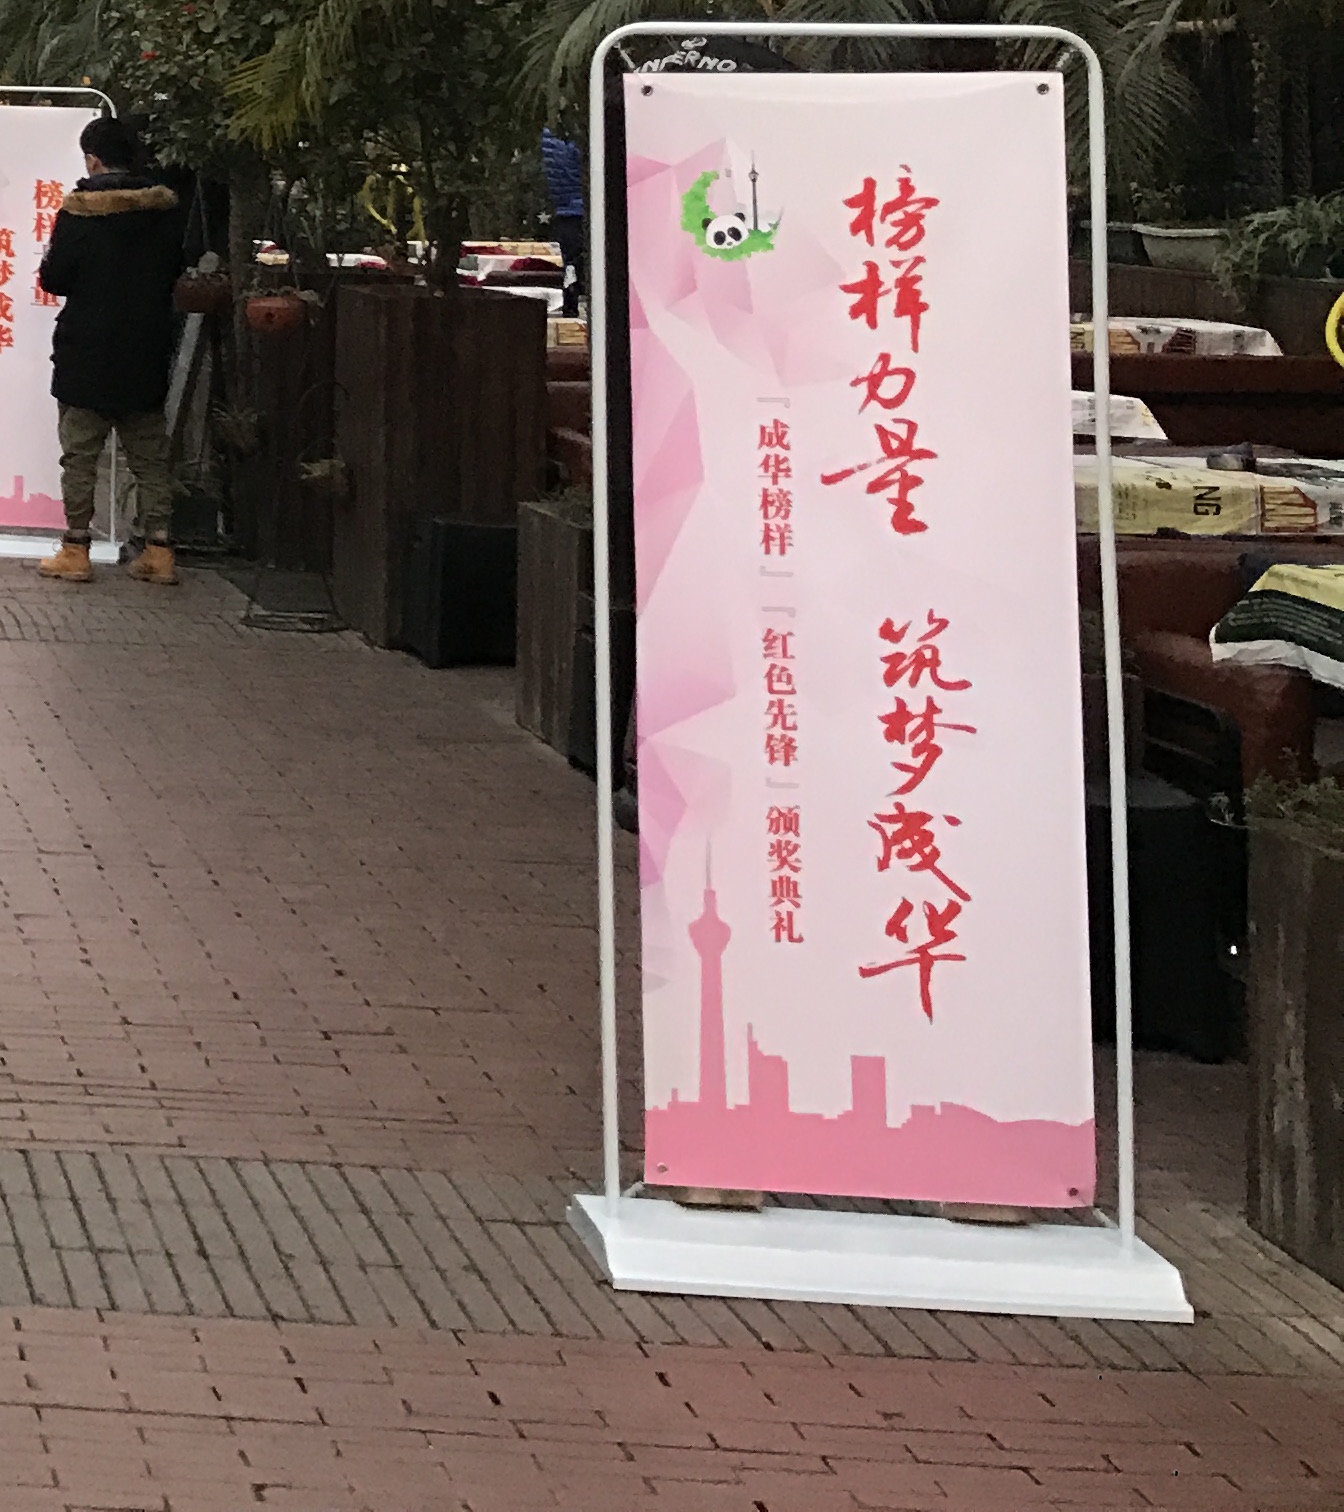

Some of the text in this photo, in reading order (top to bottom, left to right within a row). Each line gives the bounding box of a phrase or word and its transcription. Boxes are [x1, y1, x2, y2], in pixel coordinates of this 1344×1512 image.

[633, 50, 738, 74] NFERNO
[820, 164, 977, 1025] 榜样力量 筑梦成华
